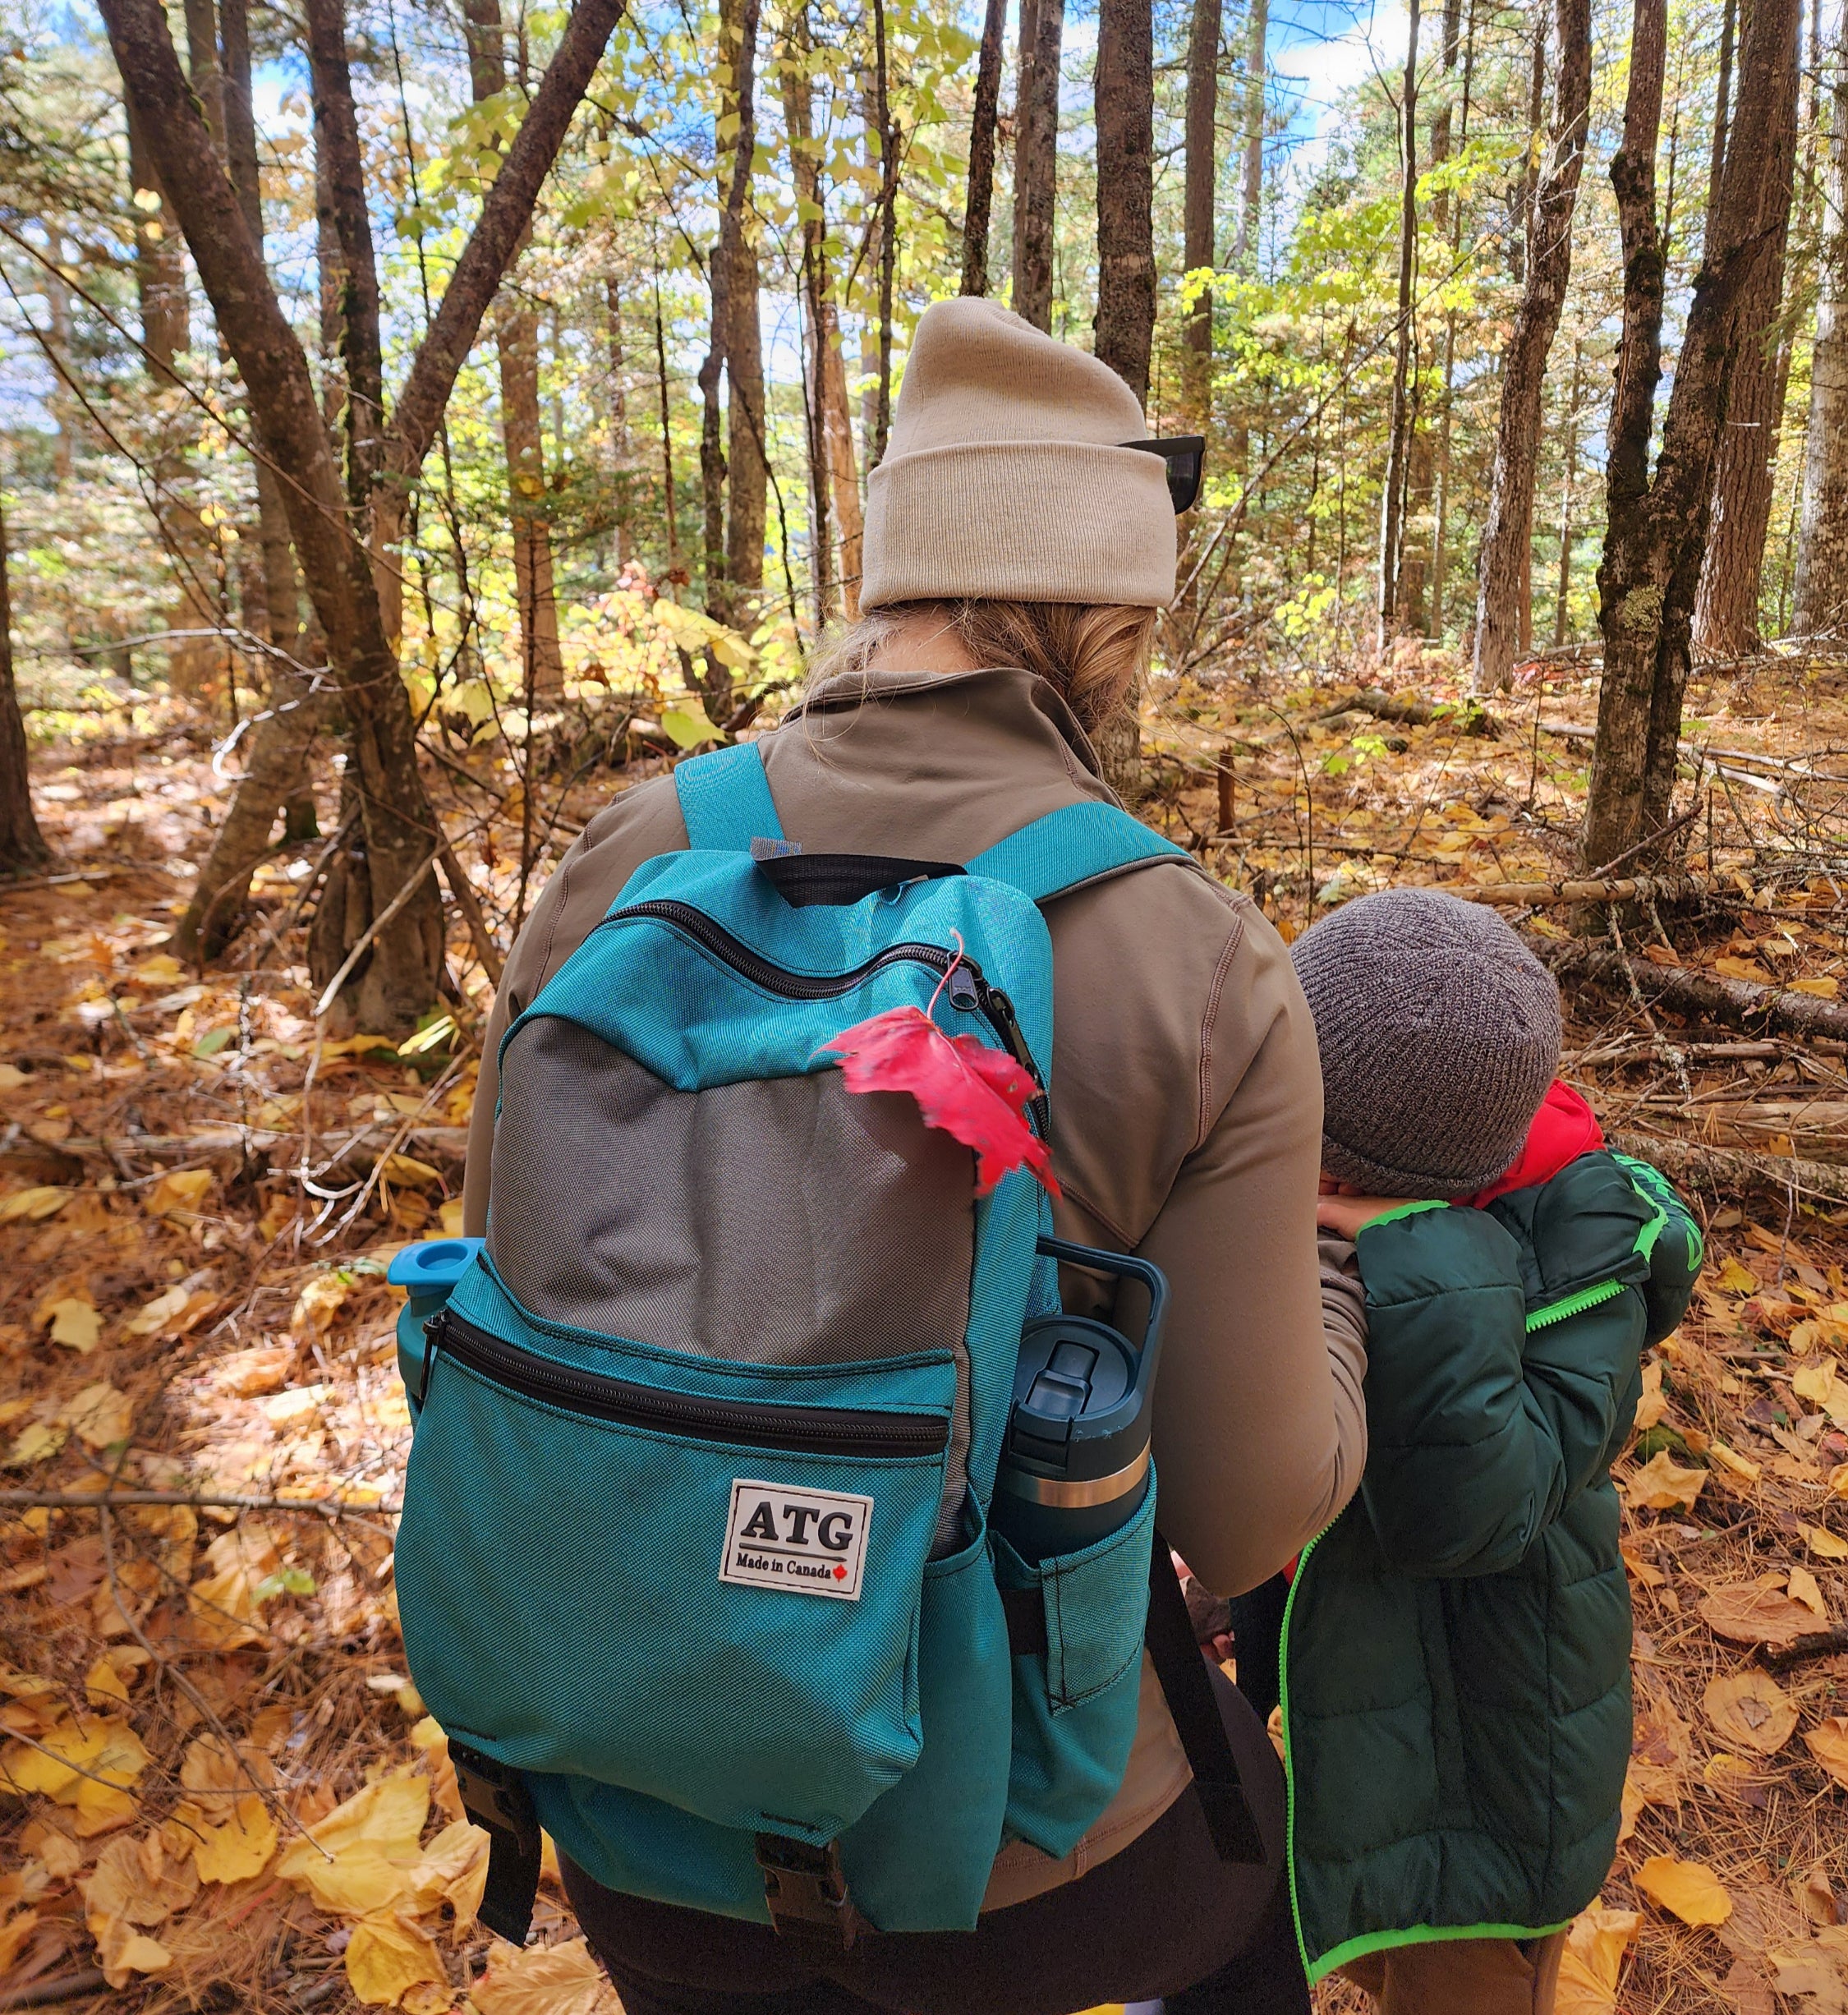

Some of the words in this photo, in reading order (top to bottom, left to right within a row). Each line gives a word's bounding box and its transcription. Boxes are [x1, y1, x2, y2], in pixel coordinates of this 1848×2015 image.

[740, 1501, 853, 1551] ATG
[736, 1553, 769, 1571] Made
[772, 1558, 784, 1572] in
[787, 1560, 831, 1580] Canada
